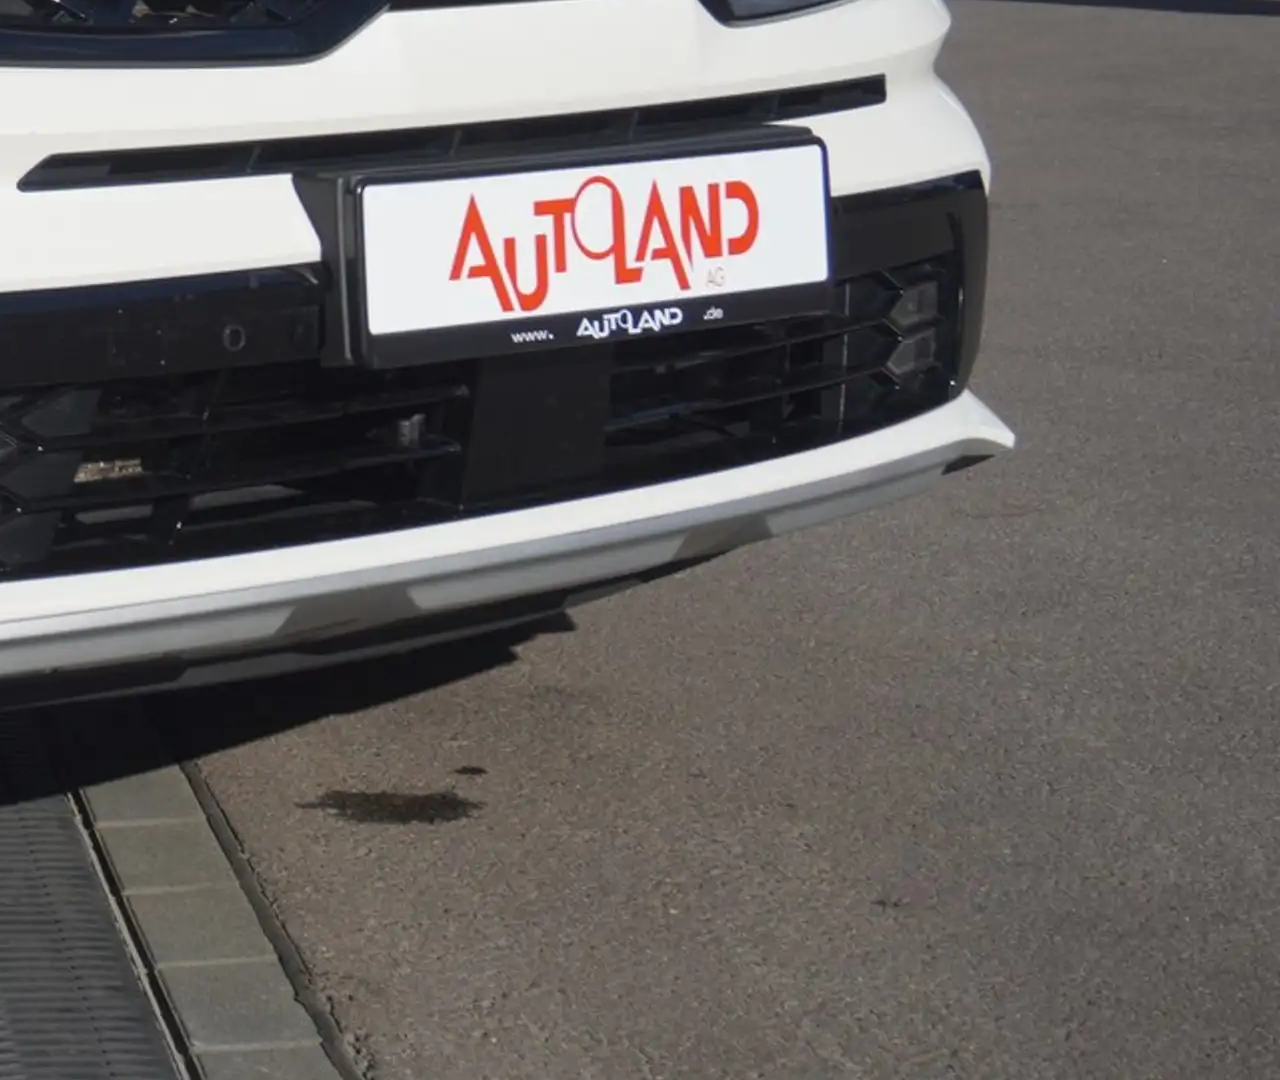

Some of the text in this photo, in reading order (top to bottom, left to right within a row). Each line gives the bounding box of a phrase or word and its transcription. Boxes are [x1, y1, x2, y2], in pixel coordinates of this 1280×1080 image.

[449, 175, 760, 313] AUTOLAND
[705, 266, 726, 288] AG
[576, 307, 684, 340] AUTOLAND
